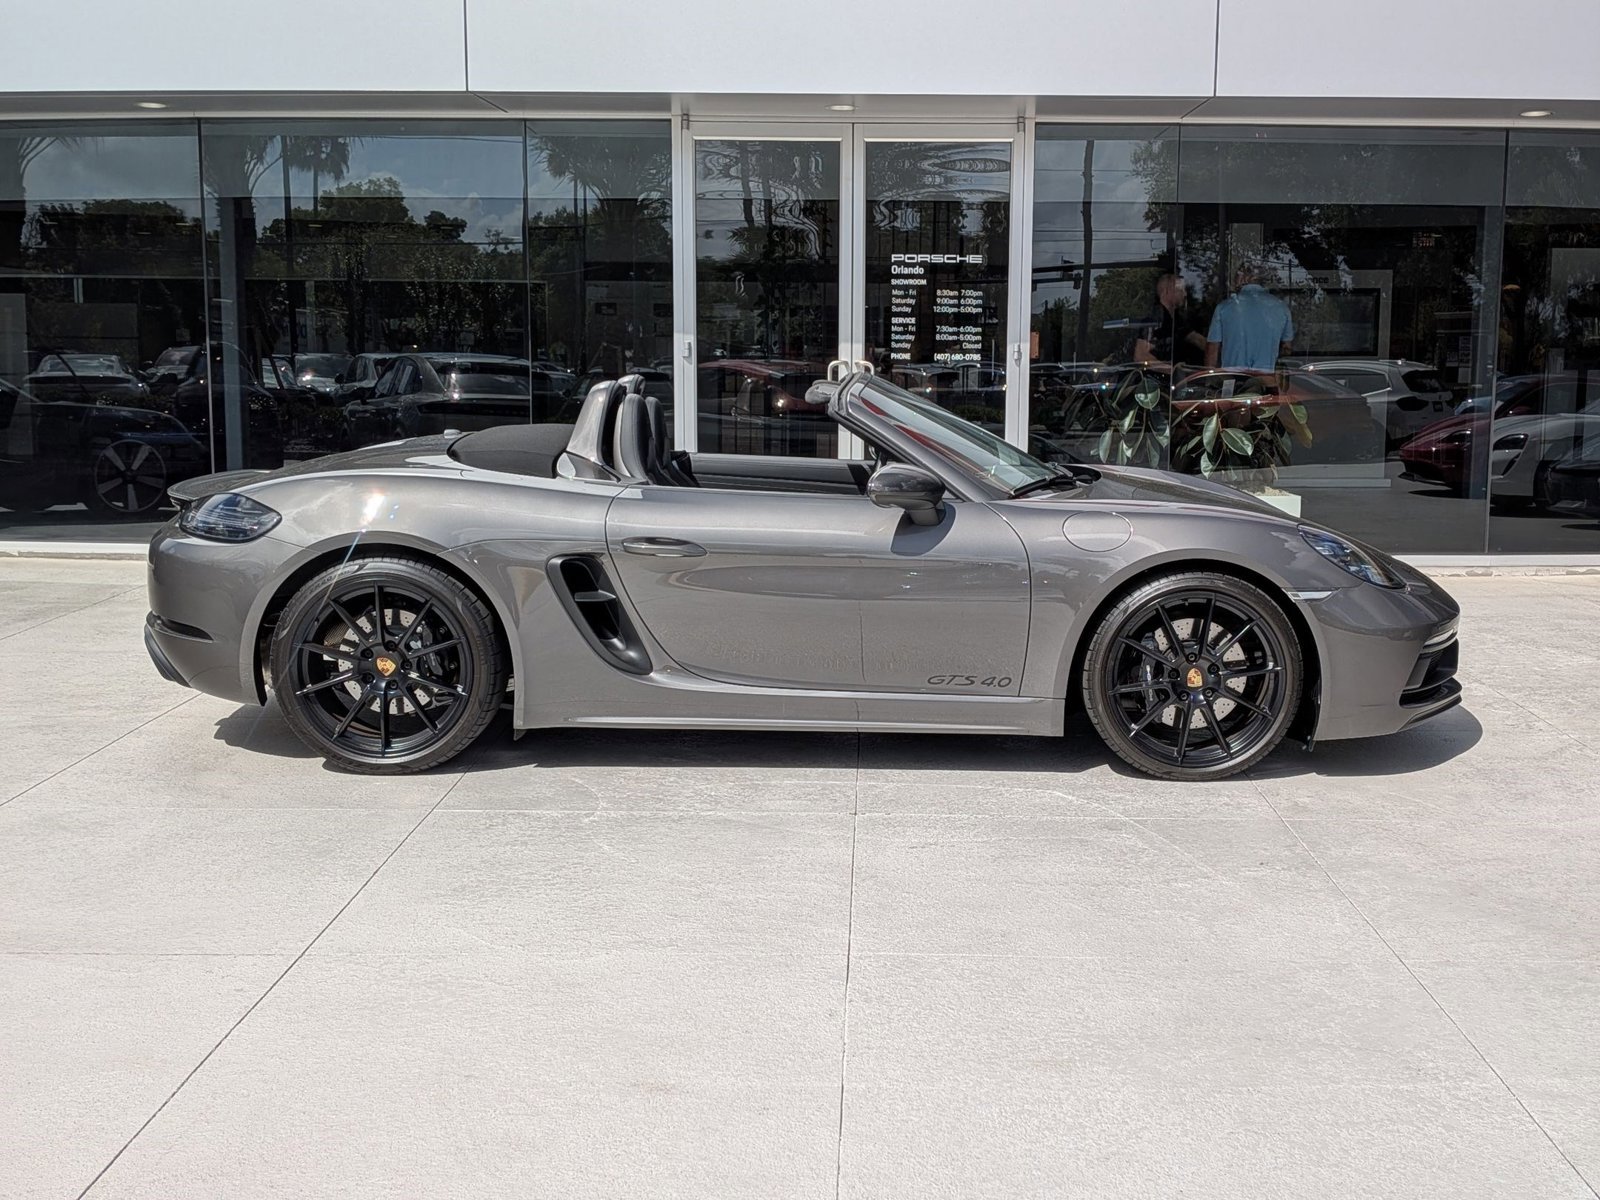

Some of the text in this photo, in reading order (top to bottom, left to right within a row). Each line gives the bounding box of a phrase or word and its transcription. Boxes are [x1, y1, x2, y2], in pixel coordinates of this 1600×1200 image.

[891, 254, 983, 263] PORSCHE
[891, 265, 924, 274] Orlando
[891, 333, 915, 341] Saturday
[927, 675, 1012, 688] GTS 4.0
